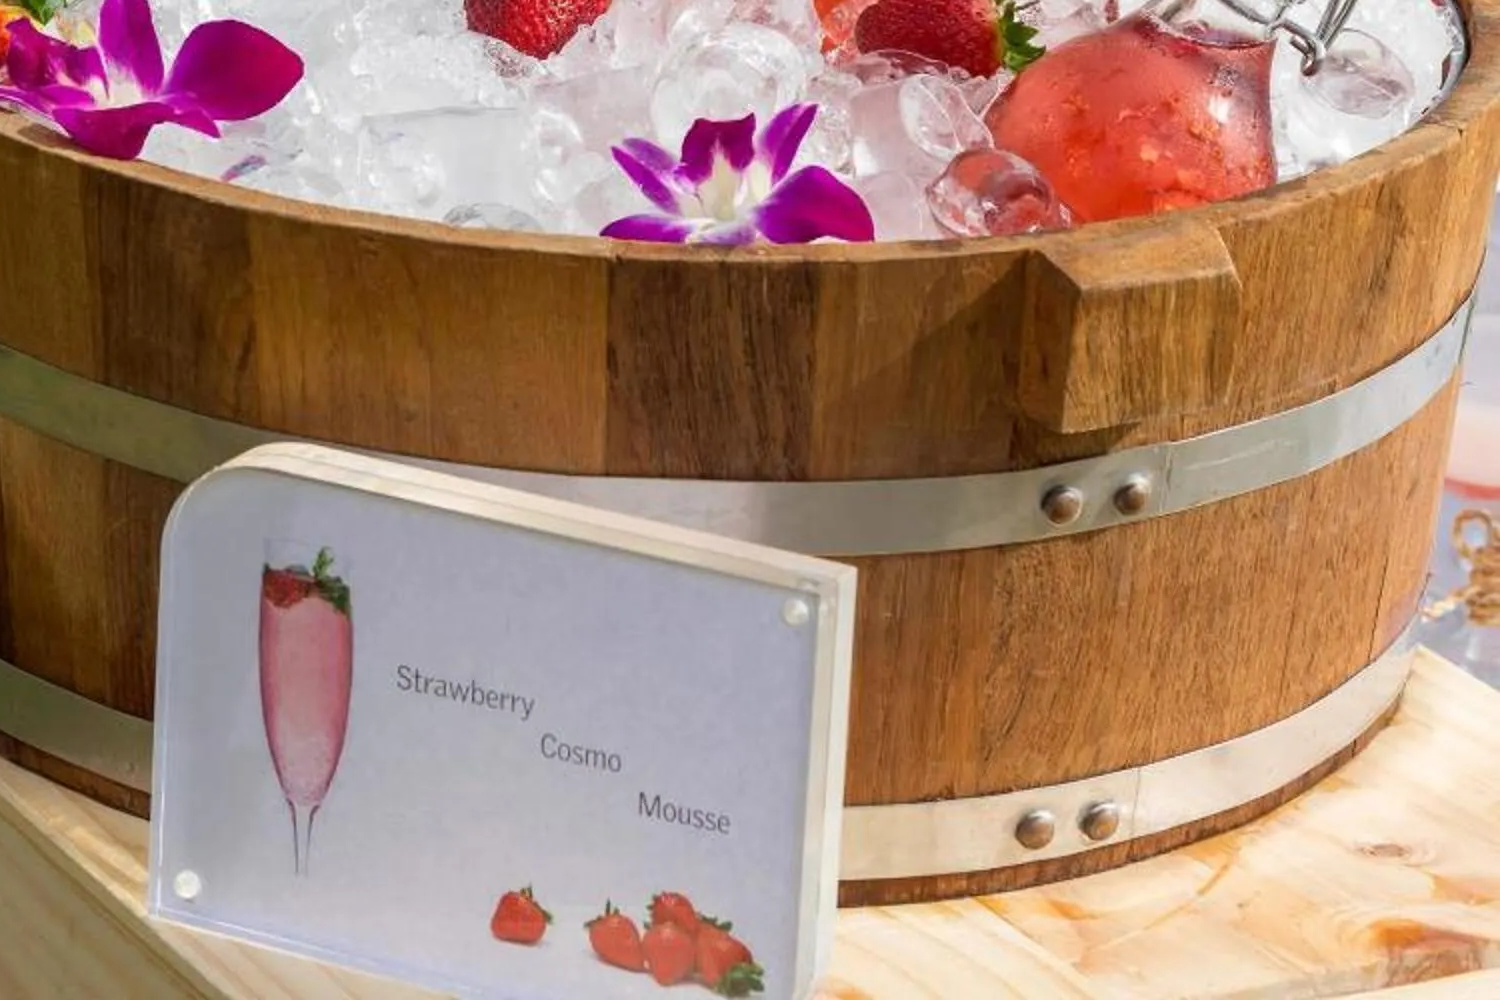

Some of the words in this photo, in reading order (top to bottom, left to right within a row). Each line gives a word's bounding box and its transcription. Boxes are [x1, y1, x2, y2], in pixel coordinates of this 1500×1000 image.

[396, 664, 536, 722] Strawberry
[540, 732, 622, 774] Cosmo
[637, 791, 732, 836] Mousse
